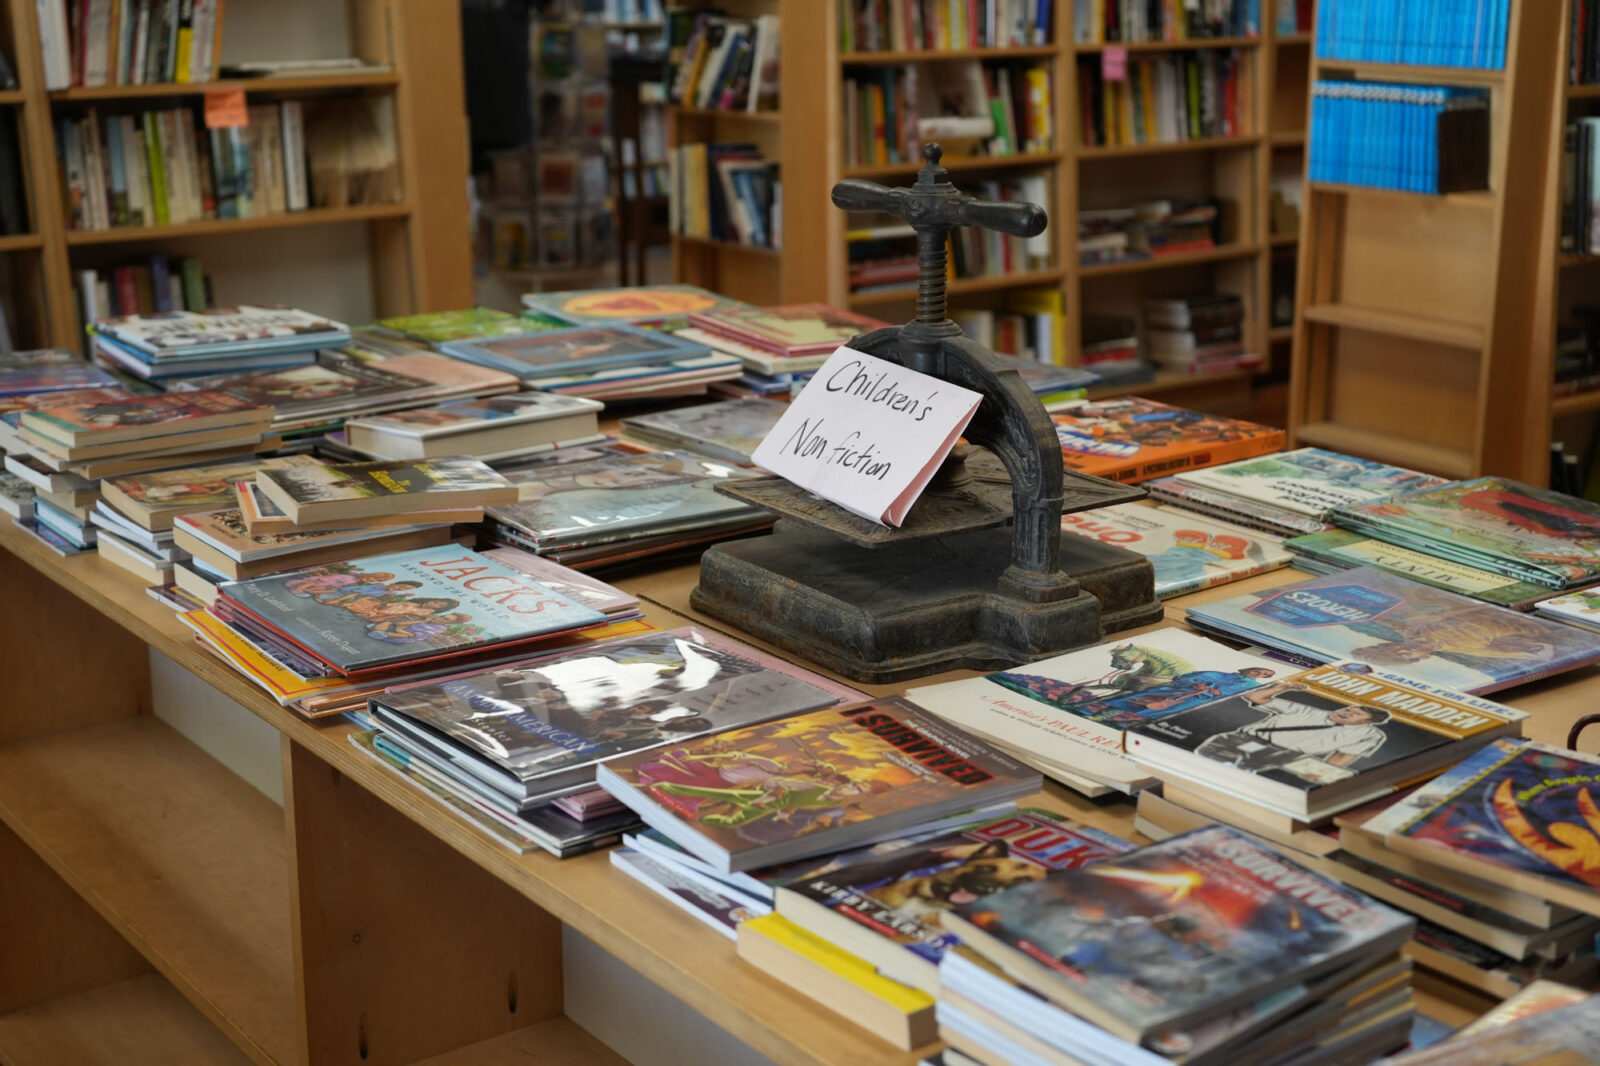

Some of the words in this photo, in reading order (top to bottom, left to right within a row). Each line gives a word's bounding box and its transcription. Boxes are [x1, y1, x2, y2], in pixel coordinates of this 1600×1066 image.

[826, 360, 936, 422] Children's
[779, 418, 828, 460] Non
[829, 431, 892, 482] fiction
[401, 563, 444, 586] AROUND
[420, 556, 568, 614] JACKS
[444, 586, 468, 598] THE
[1210, 575, 1231, 586] More
[470, 598, 510, 620] WORLD
[1283, 590, 1371, 621] HEROES
[839, 705, 876, 717] I
[1304, 671, 1384, 696] JOHN
[1372, 691, 1491, 730] MADDEN
[1384, 674, 1432, 691] GAME
[1432, 689, 1468, 702] FOR
[1467, 699, 1509, 715] LIFE
[853, 713, 996, 787] SURVIVED
[980, 696, 1048, 722] America's
[1048, 719, 1091, 741] PAUL
[1089, 734, 1124, 751] REV
[976, 817, 1109, 870] DUK
[1205, 839, 1386, 931] SURVIVED
[809, 880, 872, 911] KIRBY
[872, 910, 948, 949] LARSO
